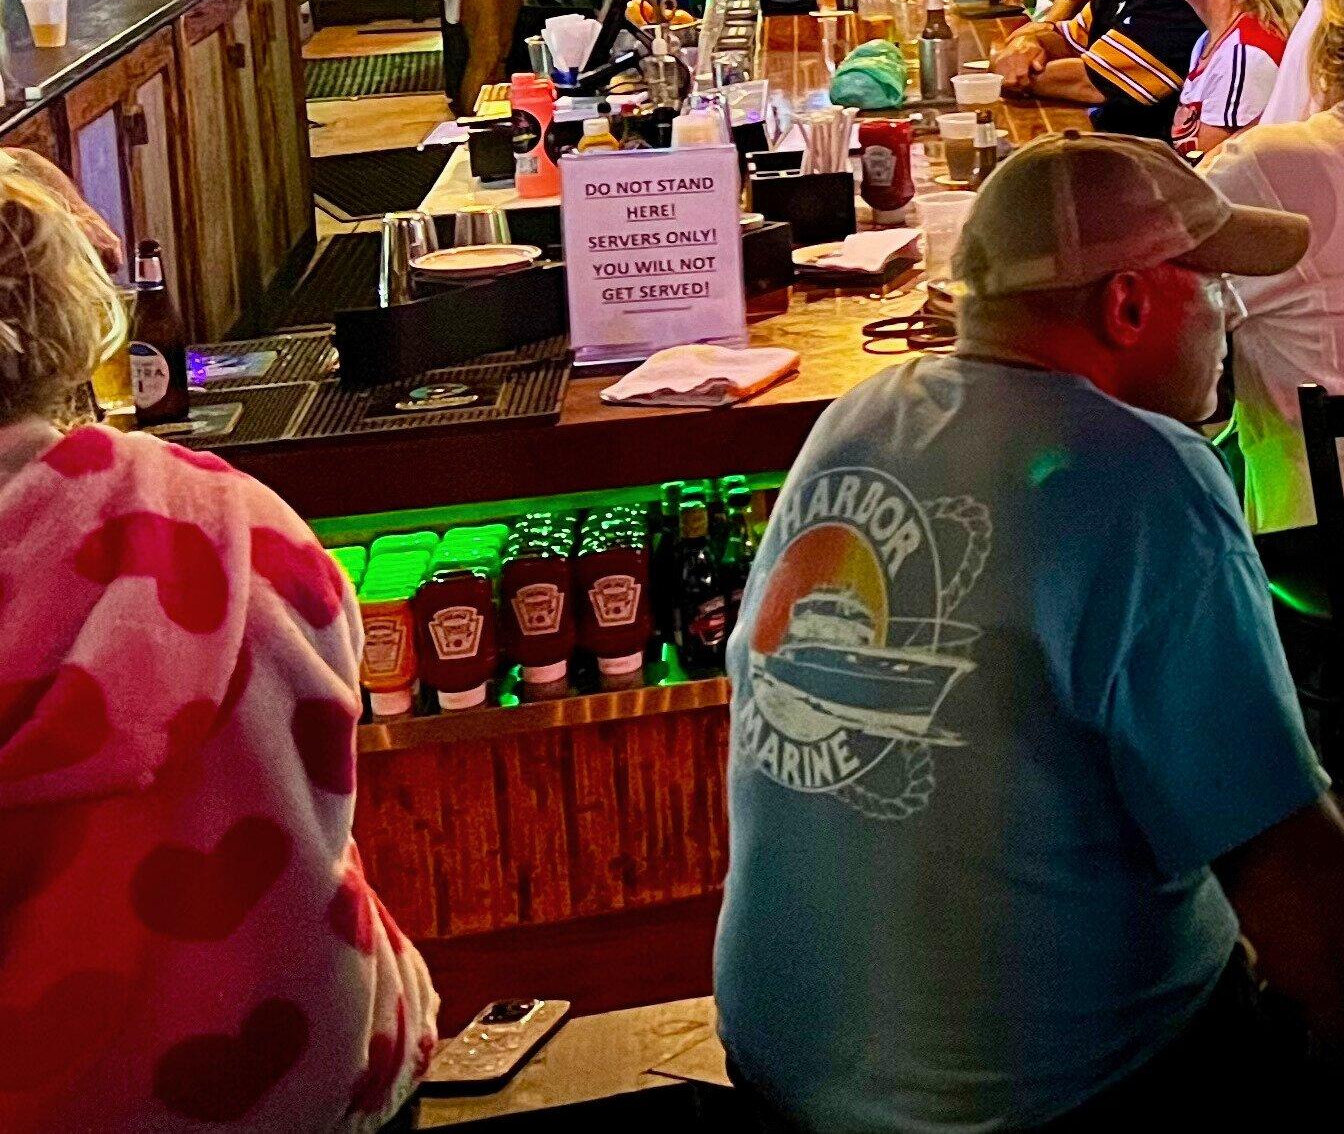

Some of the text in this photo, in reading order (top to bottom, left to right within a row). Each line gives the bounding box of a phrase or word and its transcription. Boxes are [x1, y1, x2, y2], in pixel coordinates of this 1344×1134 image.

[585, 177, 714, 196] DO NOT STAND
[626, 203, 676, 219] HERE!
[588, 228, 717, 249] SERVERS ONLY!
[593, 257, 716, 277] YOU WILL NOT
[602, 281, 710, 301] GET SERVED!
[781, 474, 921, 580] HARBOR
[738, 700, 861, 788] MARINE
